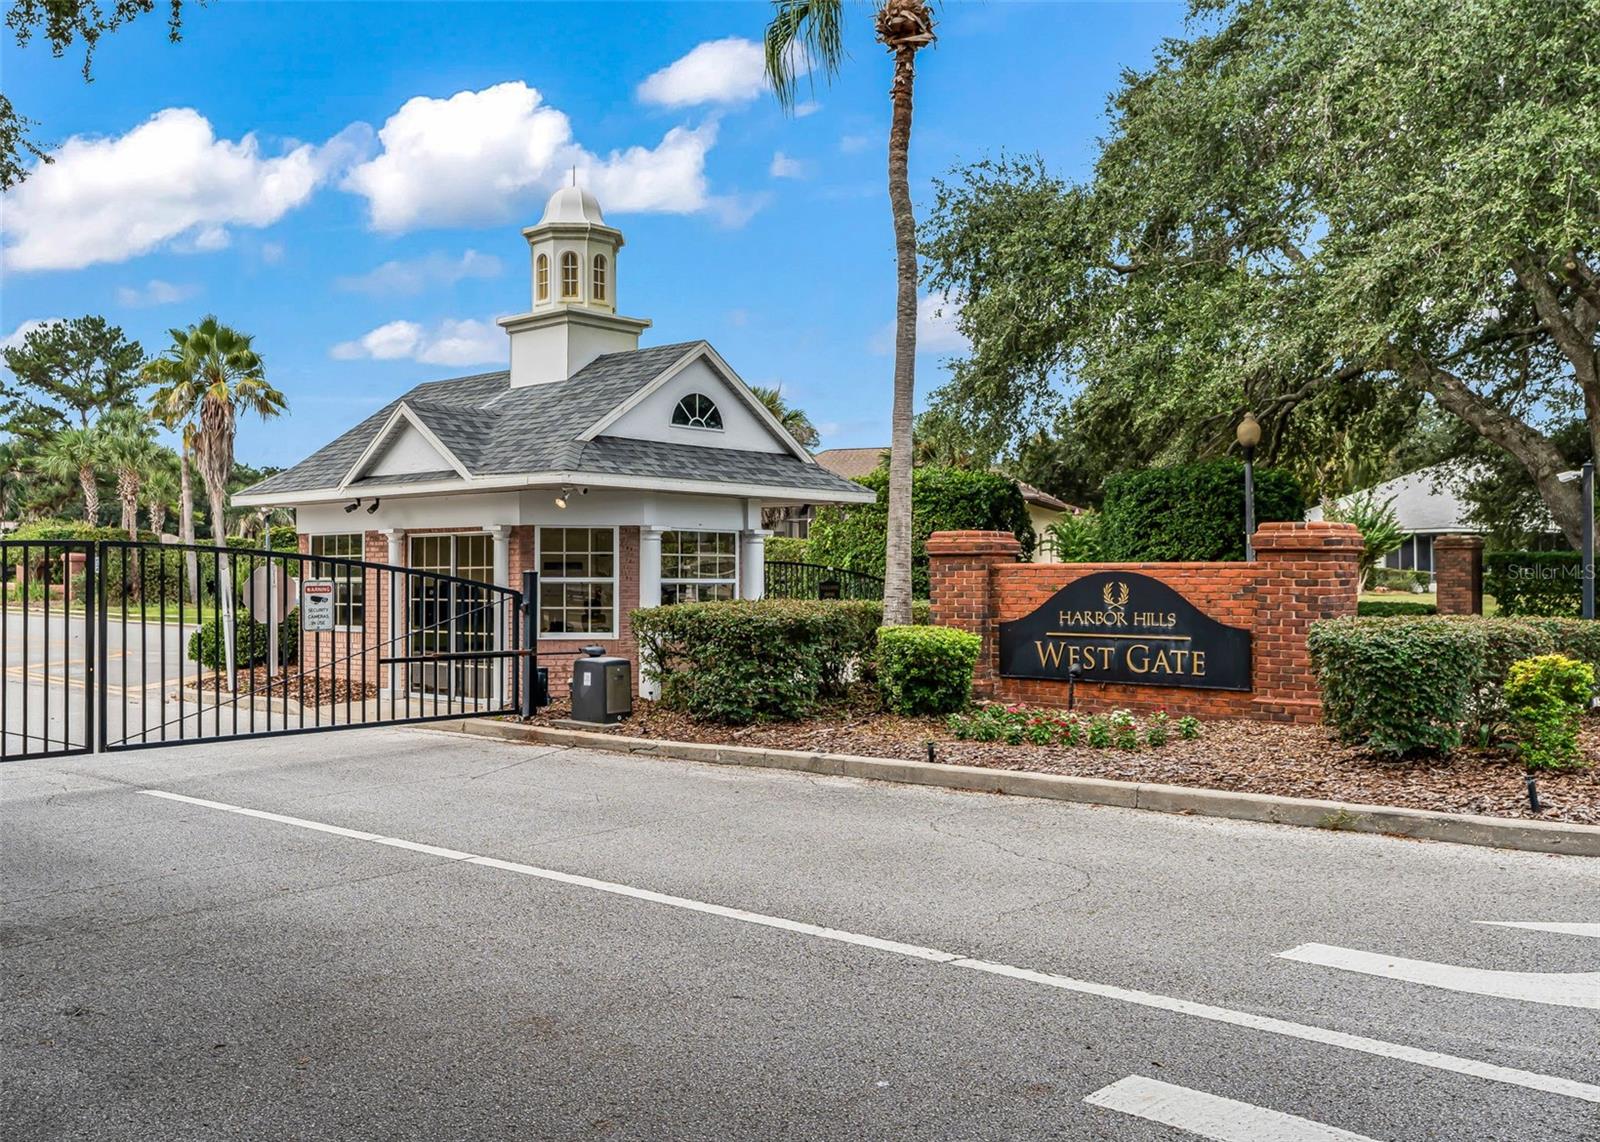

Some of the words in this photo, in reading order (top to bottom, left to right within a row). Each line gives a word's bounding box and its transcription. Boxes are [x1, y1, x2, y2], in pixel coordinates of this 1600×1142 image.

[1058, 610, 1129, 627] HARBOR
[1133, 611, 1177, 628] HILLS
[1034, 640, 1116, 671] WEST
[1125, 644, 1207, 677] GATE
